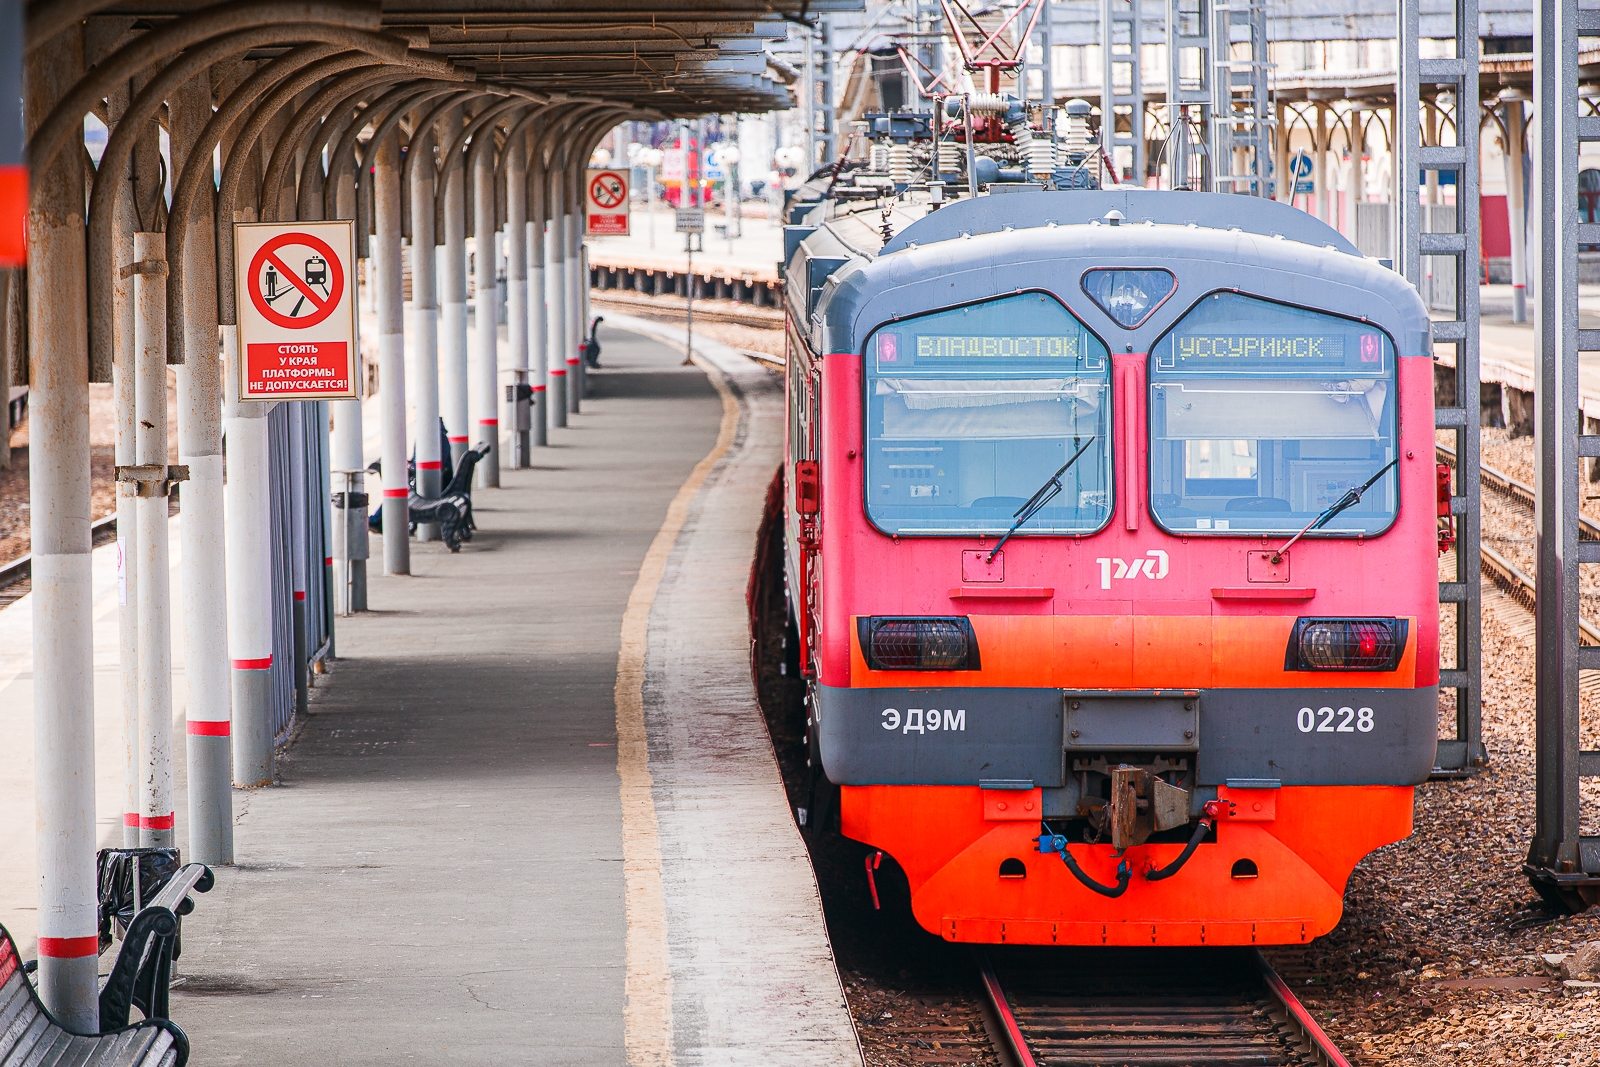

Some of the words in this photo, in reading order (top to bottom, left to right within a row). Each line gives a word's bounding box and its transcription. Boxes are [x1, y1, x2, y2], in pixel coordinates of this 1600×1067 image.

[278, 345, 318, 354] СТОЯТЬ
[918, 336, 1079, 357] ВЛАДВОСТОК
[1180, 337, 1324, 357] УССУРИЙСК
[279, 357, 287, 366] У
[289, 357, 317, 366] КРАЯ
[262, 368, 335, 378] ПЛАТФОРМЫ
[249, 381, 264, 390] НЕ
[265, 380, 347, 391] ДОПУСКАЕТСЯ!
[881, 708, 966, 735] ЭД9М
[1297, 706, 1375, 733] 0228
